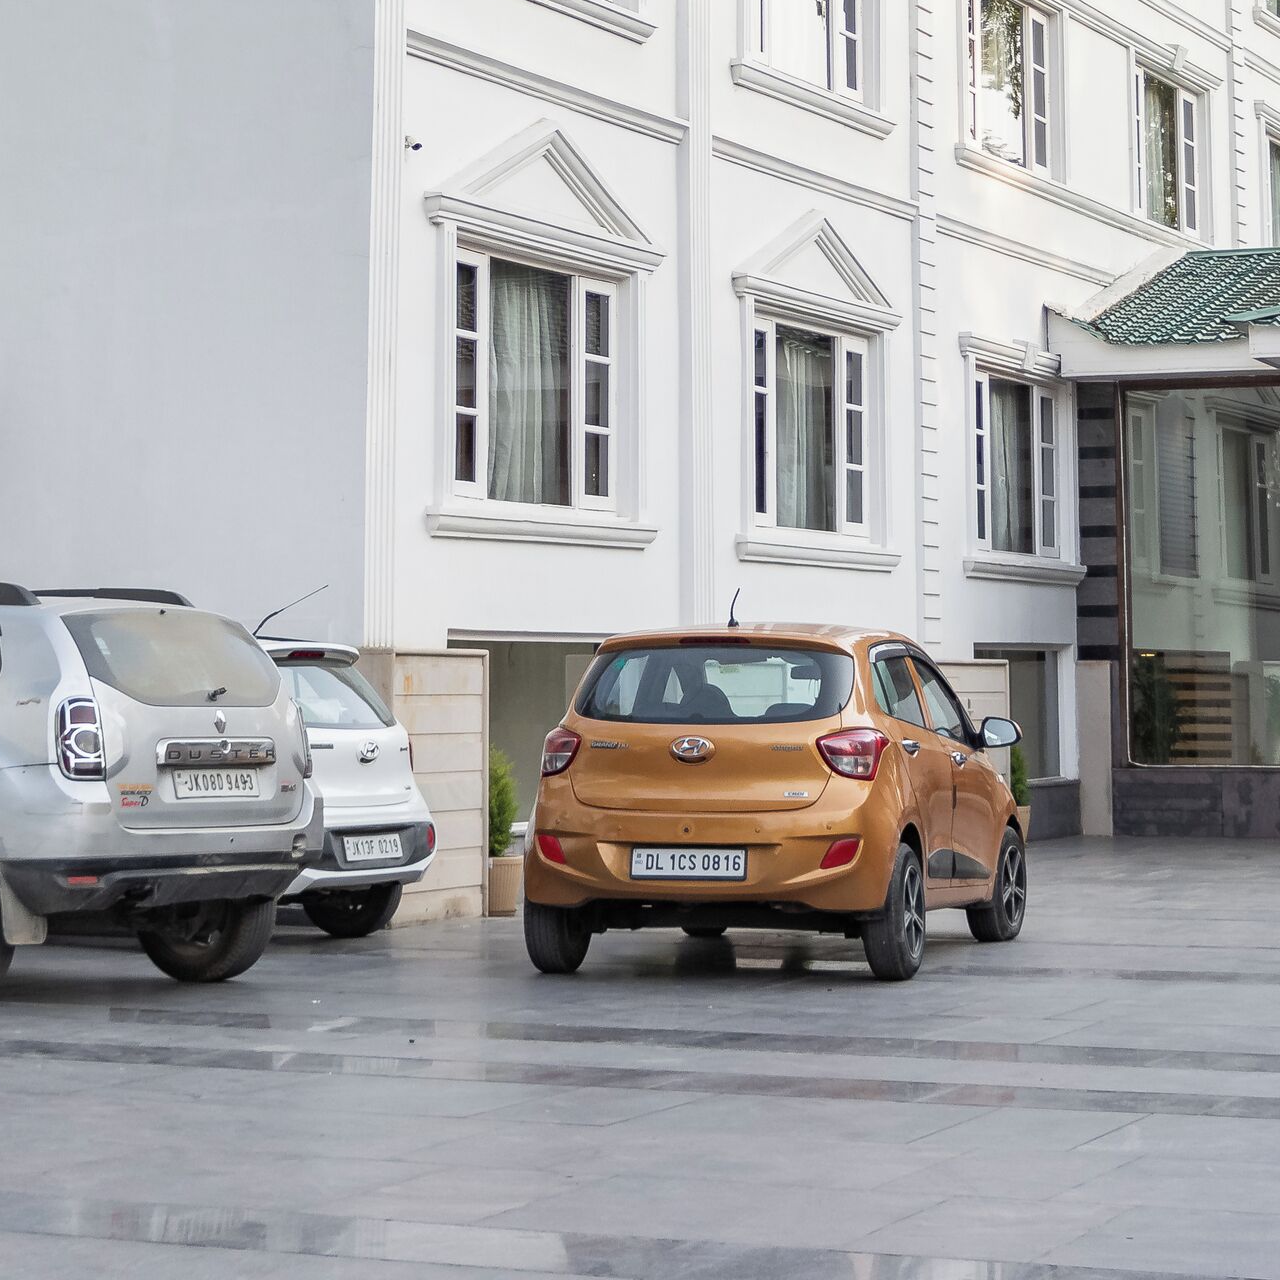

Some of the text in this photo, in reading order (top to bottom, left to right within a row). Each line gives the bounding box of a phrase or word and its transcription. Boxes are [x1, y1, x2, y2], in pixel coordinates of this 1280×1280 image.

[168, 749, 275, 760] DUSTER
[645, 853, 741, 871] DL 1CS 0816
